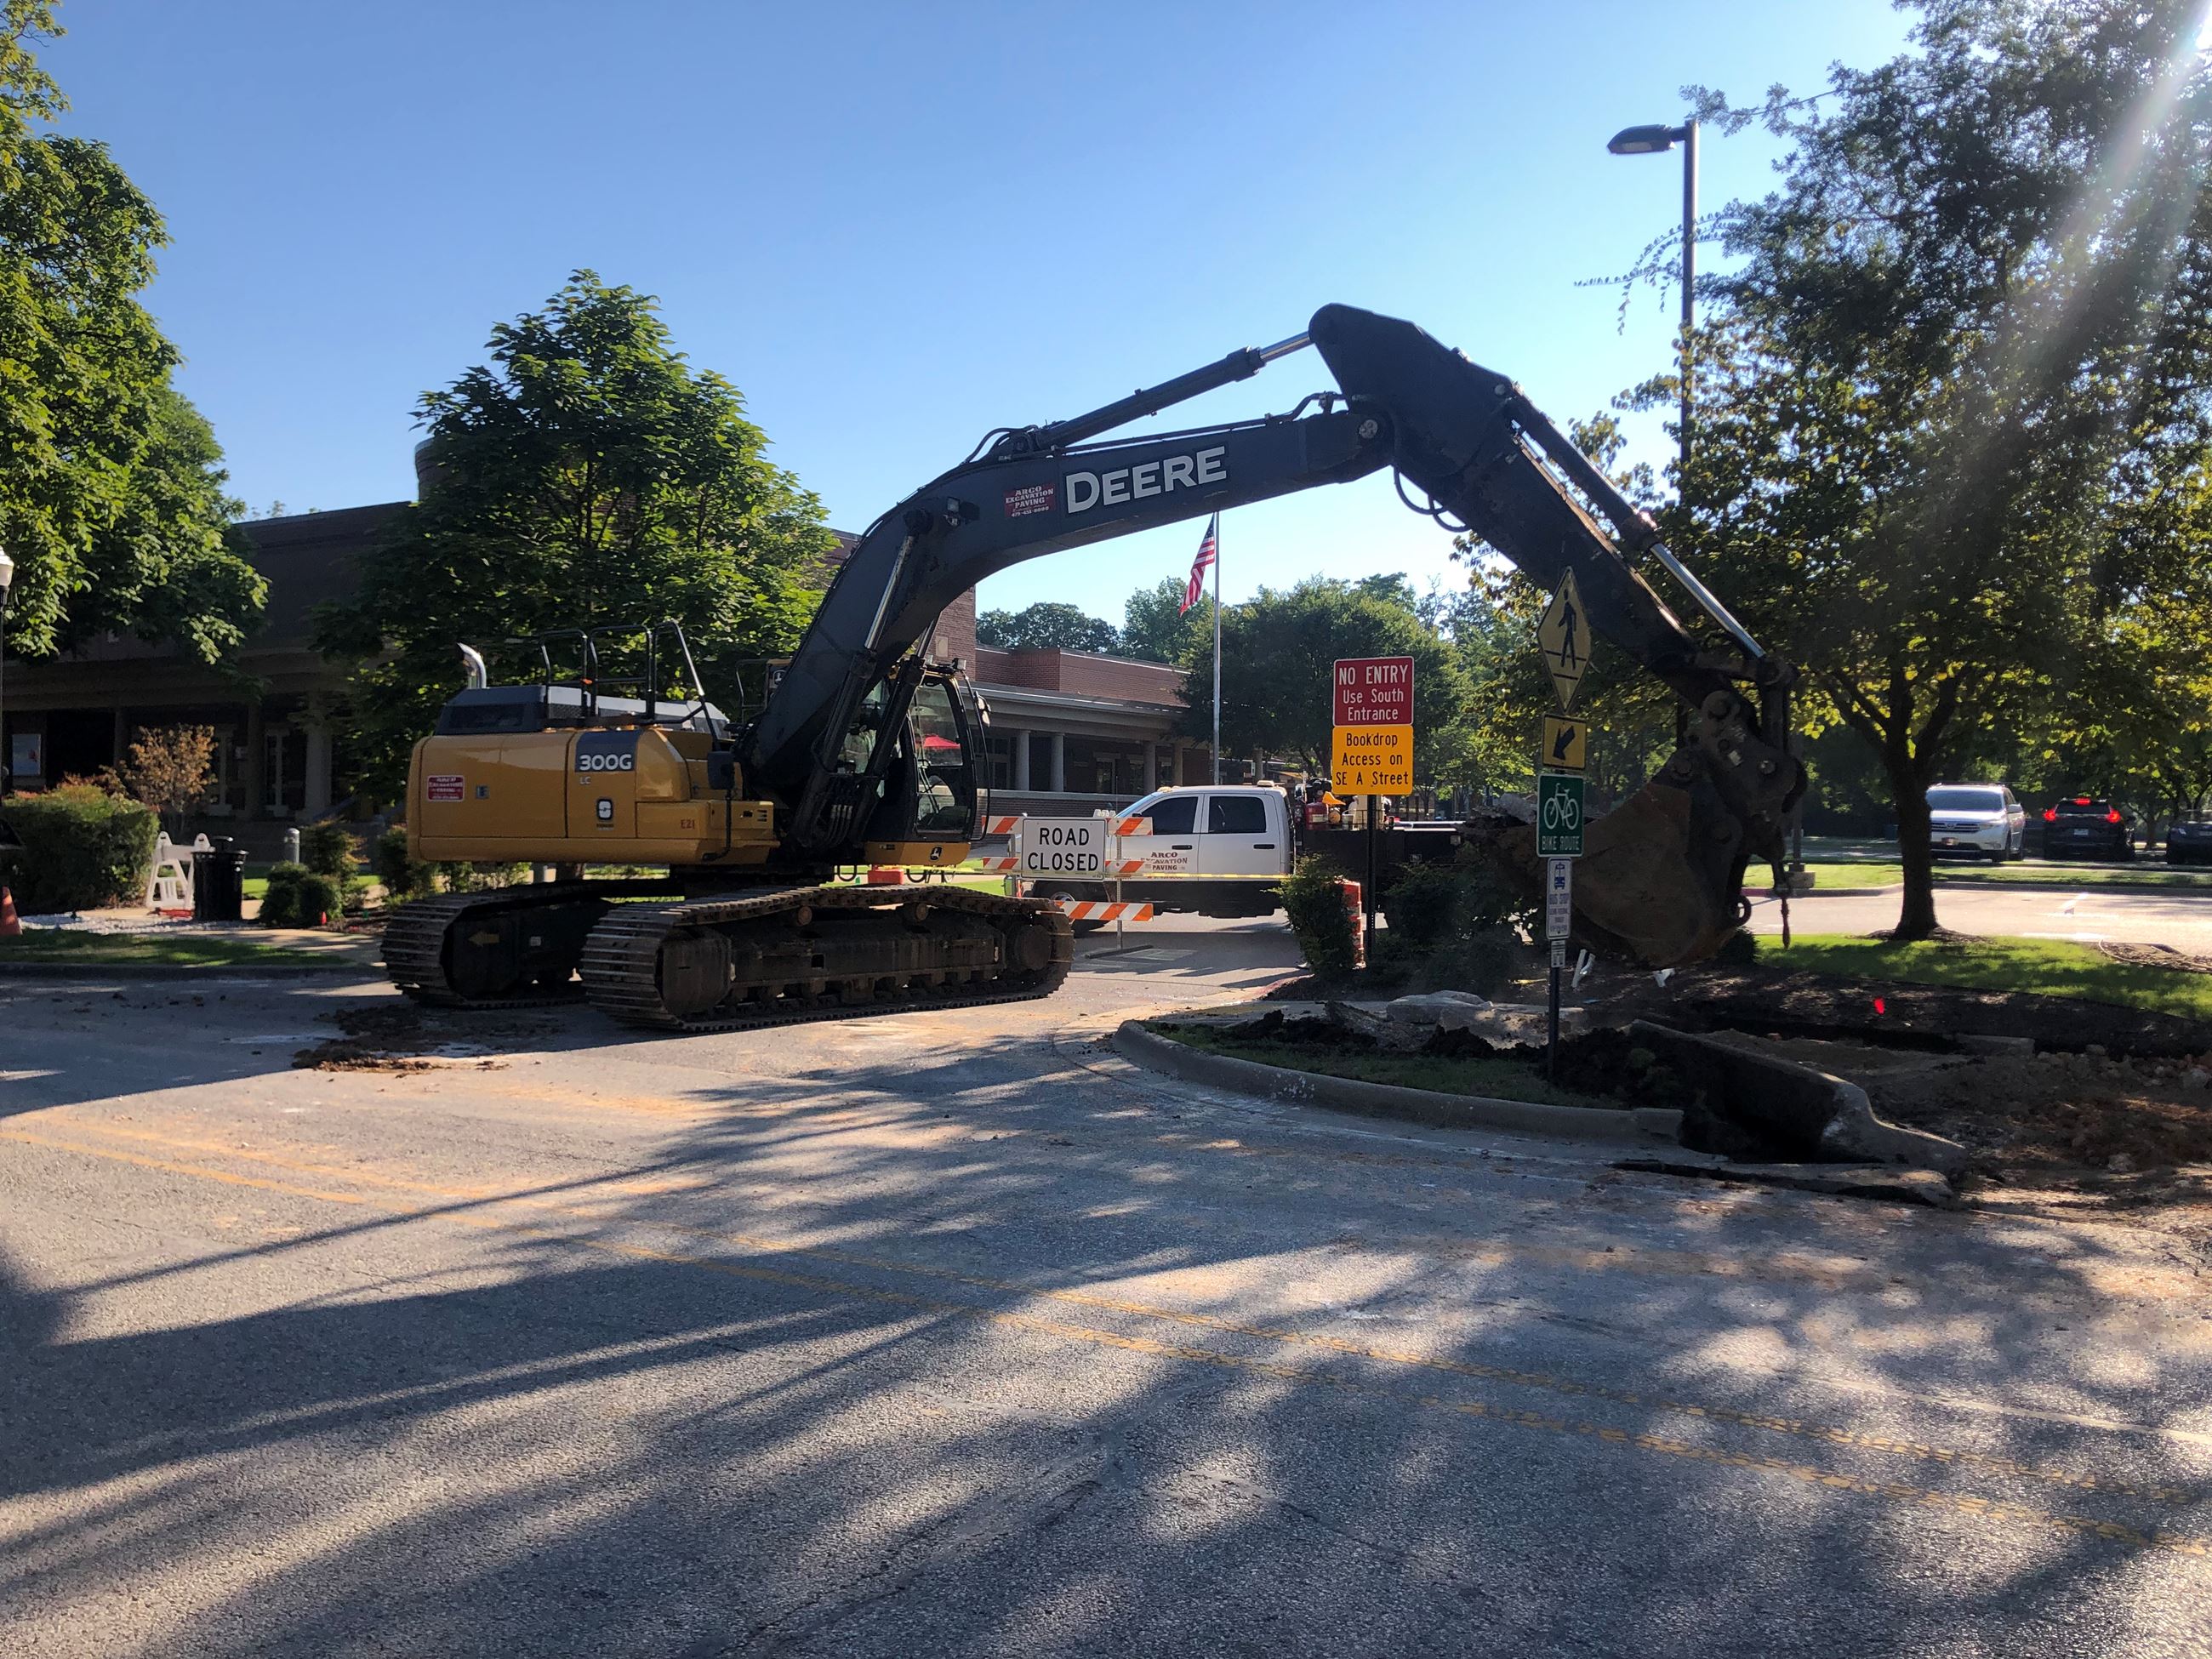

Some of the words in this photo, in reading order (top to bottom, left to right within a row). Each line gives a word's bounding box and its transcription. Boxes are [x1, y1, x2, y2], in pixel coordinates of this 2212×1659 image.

[1066, 446, 1227, 514] DEERE
[1006, 488, 1054, 504] EXCAVATION
[1015, 486, 1042, 497] ARCO
[1014, 497, 1046, 509] PAVING
[1338, 667, 1355, 686] NO
[1365, 664, 1408, 685] ENTRY
[1343, 689, 1363, 704] Use
[1371, 687, 1404, 703] South
[1348, 706, 1399, 721] Entrance
[1346, 733, 1398, 748] Bookdrop
[579, 754, 632, 771] 300G
[1342, 752, 1381, 766] Access
[1389, 754, 1403, 766] on
[1336, 772, 1348, 785] SE
[1356, 772, 1363, 785] A
[1372, 771, 1409, 785] Street
[1039, 828, 1090, 846] ROAD
[1542, 835, 1558, 851] BIKE
[1028, 852, 1099, 872] CLOSED
